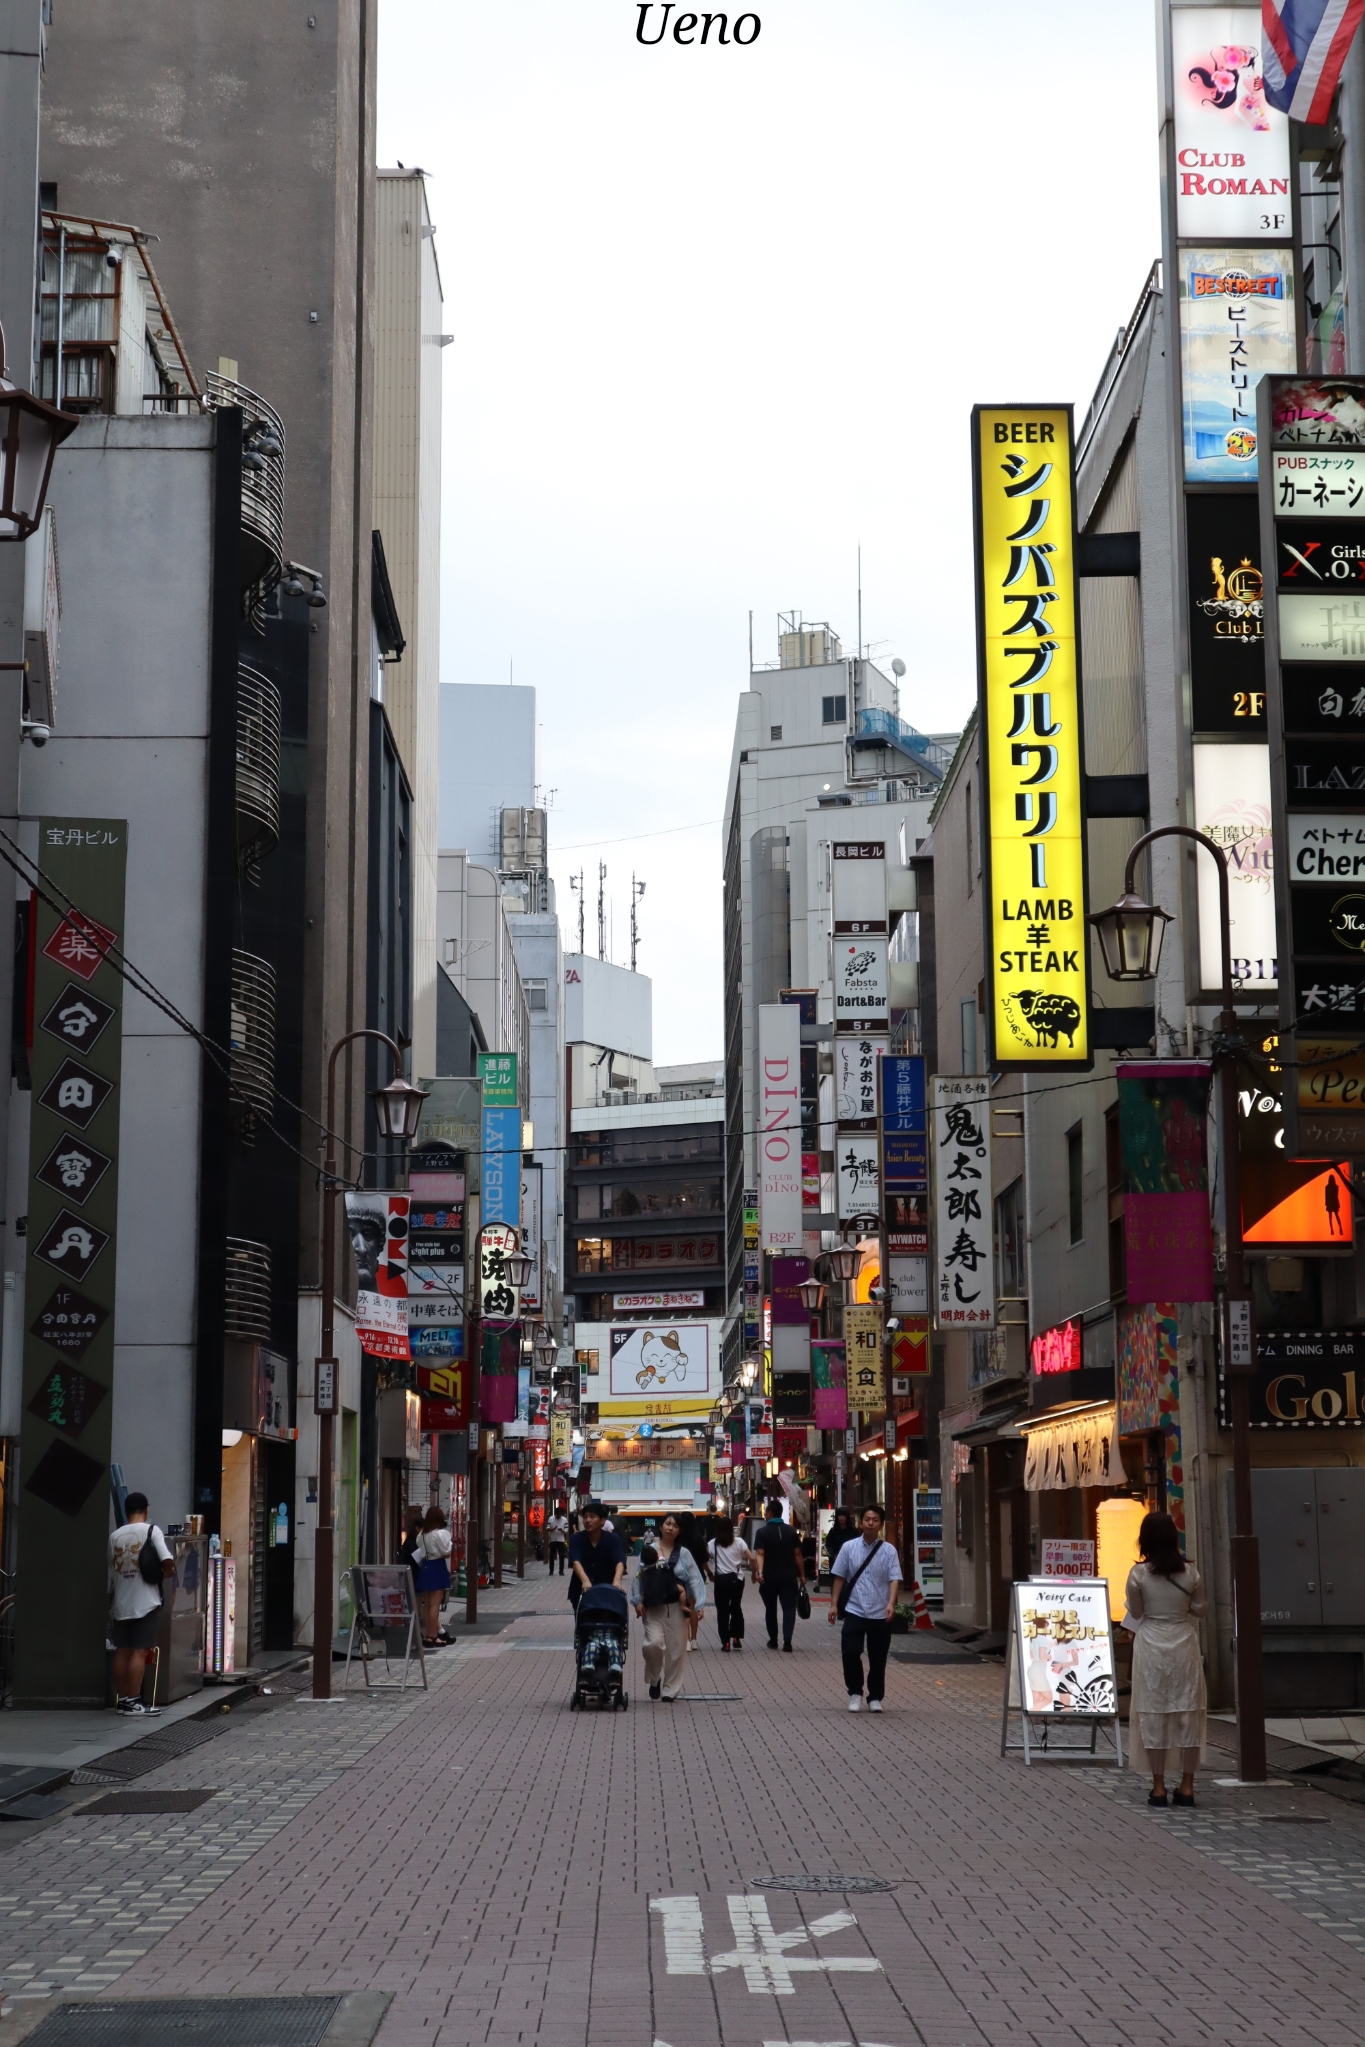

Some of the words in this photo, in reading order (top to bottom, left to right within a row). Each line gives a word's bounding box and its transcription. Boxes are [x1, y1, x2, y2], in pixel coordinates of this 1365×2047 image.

[1178, 148, 1246, 168] CLUB
[1180, 172, 1290, 197] ROMAN
[1260, 214, 1285, 230] 3F
[1194, 275, 1279, 296] BESTREET
[1228, 306, 1248, 423] ビーストリート
[1280, 406, 1329, 422] カレン
[994, 422, 1055, 444] BEER
[1227, 436, 1257, 456] 2F
[1215, 621, 1251, 635] Club
[1000, 454, 1062, 888] シノバズブルワリー
[1233, 692, 1267, 717] 2F
[46, 829, 118, 847] 宝丹ビル
[835, 846, 883, 858] 長岡ビル
[1002, 899, 1074, 921] LAMB
[851, 923, 870, 932] 6F
[1026, 923, 1051, 949] 羊
[59, 926, 99, 961] 薬
[1000, 951, 1080, 973] STEAK
[845, 978, 878, 987] Fabsta
[837, 995, 887, 1007] Dart&Bar
[1301, 984, 1365, 1012] 大連
[853, 1021, 872, 1030] 5F
[485, 1059, 511, 1071] 進藤
[485, 1073, 511, 1085] ビル
[859, 1041, 875, 1112] ながおか屋
[896, 1060, 913, 1130] 第5藤井ビル
[938, 1083, 988, 1094] 地酒各種
[764, 1056, 798, 1162] DINO
[860, 1121, 868, 1129] 4F
[886, 1150, 903, 1163] Asian
[904, 1150, 926, 1165] Beauty
[485, 1111, 504, 1221] LAWSON
[765, 1178, 799, 1193] DINO
[451, 1205, 464, 1213] 4F
[856, 1221, 875, 1231] 3F
[768, 1232, 796, 1244] B2F
[888, 1234, 927, 1245] BAYWATCH
[411, 1247, 429, 1257] eight
[429, 1247, 445, 1257] plus
[614, 1241, 630, 1254] 24
[636, 1239, 717, 1263] カラオケ
[446, 1273, 461, 1284] 2F
[899, 1274, 916, 1282] club
[890, 1286, 926, 1297] Flower
[940, 1273, 950, 1302] 上野店
[56, 1293, 71, 1304] 1F
[624, 1294, 655, 1306] カラオケ
[662, 1293, 699, 1306] まねきねこ
[411, 1304, 460, 1317] 中華そば
[940, 1309, 992, 1322] 明朗会計
[374, 1319, 383, 1328] the
[397, 1321, 408, 1333] City
[1240, 1303, 1249, 1352] 上野二丁目
[419, 1331, 449, 1343] MELT
[613, 1333, 628, 1344] 5F
[1232, 1323, 1241, 1362] 仲町通り
[415, 1346, 456, 1355] PLANET
[1286, 1345, 1323, 1356] DINING
[1333, 1344, 1354, 1355] BAR
[855, 1330, 877, 1387] 和食
[1266, 1371, 1365, 1421] Gol
[616, 1444, 676, 1456] 仲町通り
[1045, 1552, 1064, 1563] 早割
[1072, 1551, 1092, 1562] 60分
[1045, 1562, 1093, 1577] 3,000円
[1036, 1591, 1066, 1604] Noisy
[1068, 1592, 1092, 1603] Cats
[1022, 1624, 1110, 1641] ガールズバー
